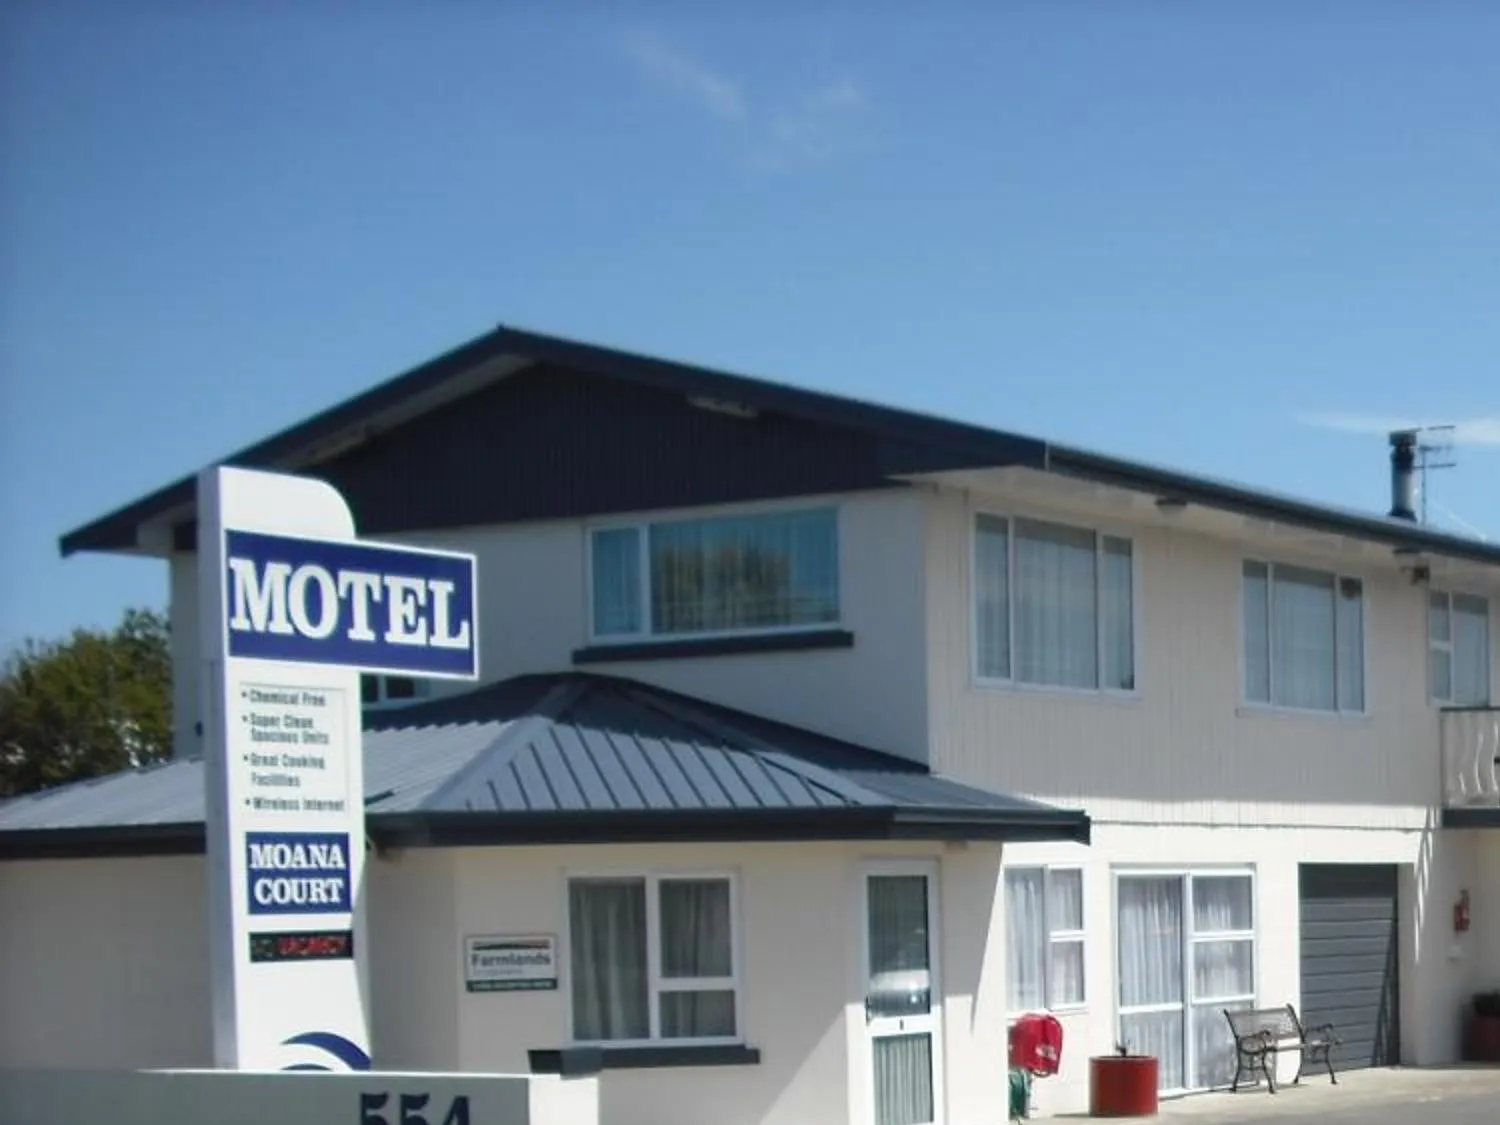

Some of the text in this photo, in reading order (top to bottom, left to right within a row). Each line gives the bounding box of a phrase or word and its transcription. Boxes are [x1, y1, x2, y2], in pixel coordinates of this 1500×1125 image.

[228, 557, 470, 649] MOTEL
[250, 689, 326, 706] Chemical Free
[250, 712, 314, 728] Super Clean
[250, 752, 325, 769] Great Cooking
[253, 796, 344, 811] Wireless Internet
[249, 843, 346, 868] MOANA
[254, 877, 345, 904] COURT
